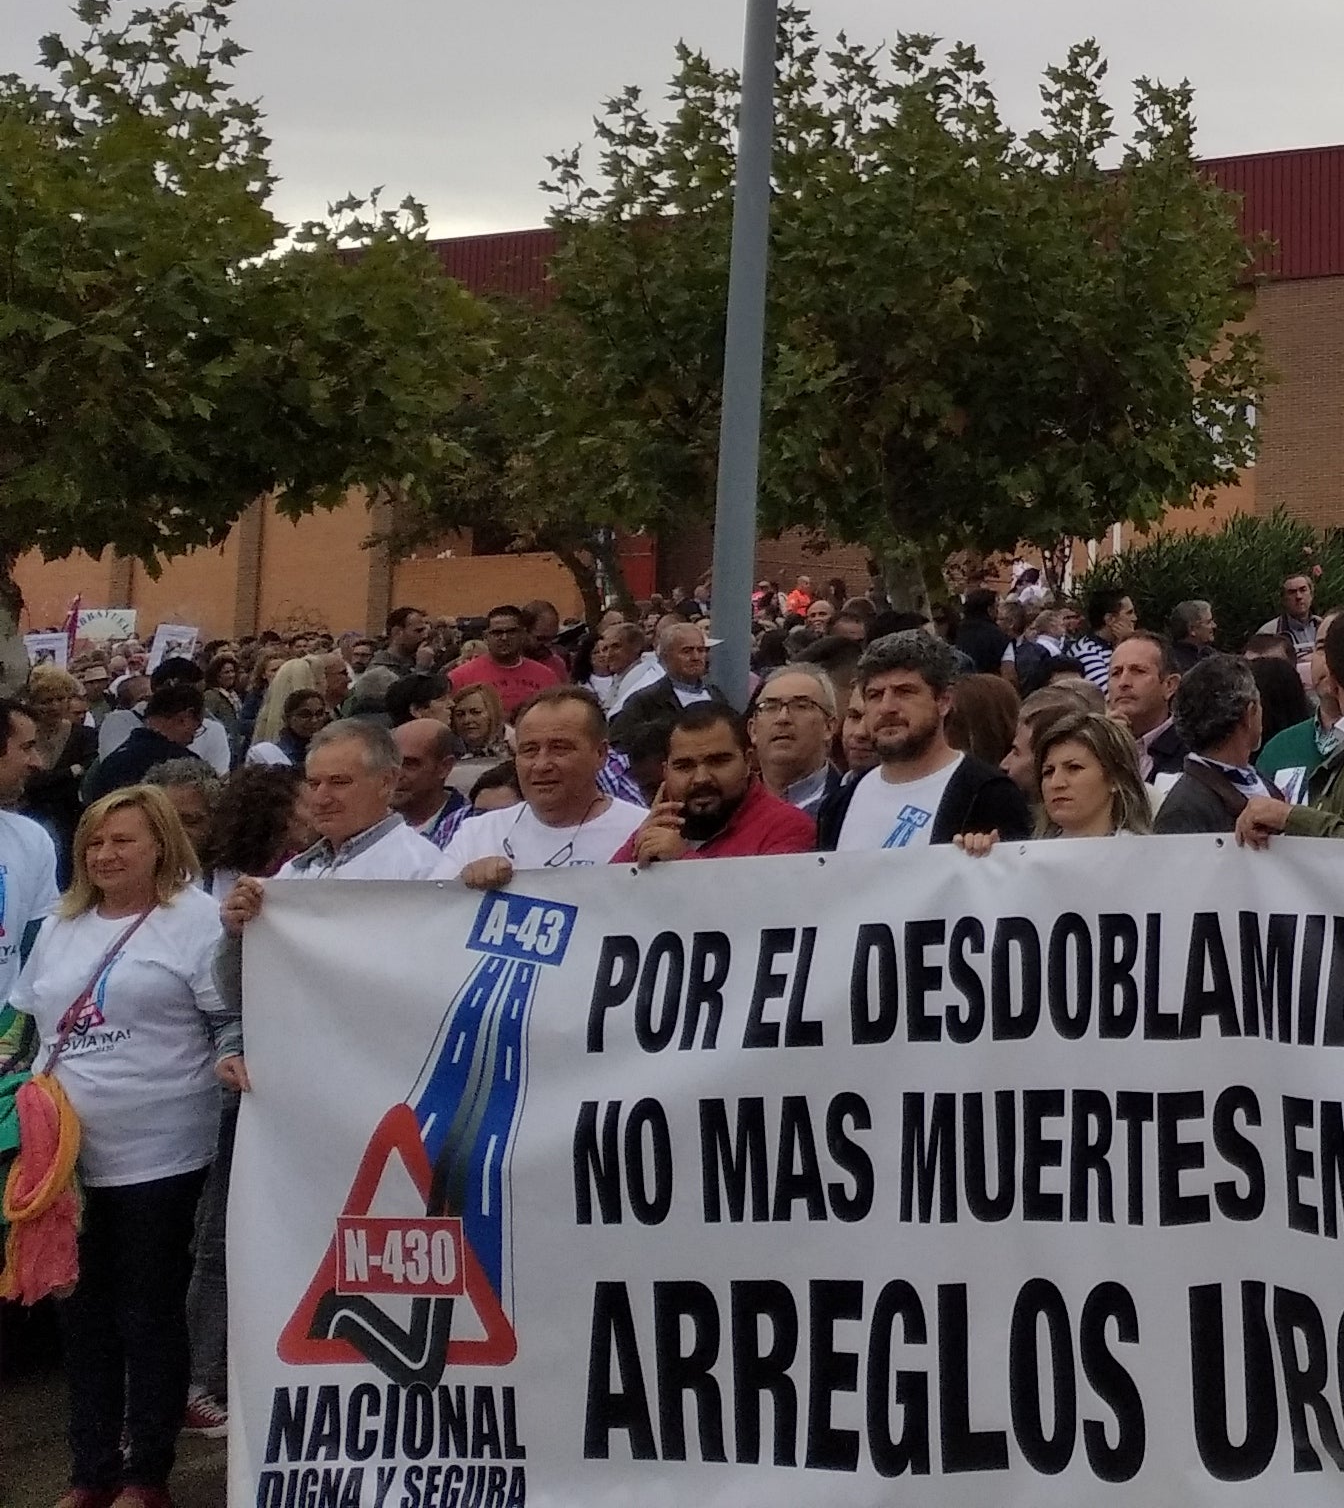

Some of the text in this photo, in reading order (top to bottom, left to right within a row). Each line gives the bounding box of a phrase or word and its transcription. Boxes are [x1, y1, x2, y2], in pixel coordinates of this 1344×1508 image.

[478, 898, 563, 958] A-43
[587, 928, 731, 1053] POR
[742, 926, 824, 1048] EL
[572, 1097, 674, 1225] NO
[699, 1091, 875, 1224] MAS
[900, 1085, 1266, 1227] MUERTES
[344, 1229, 456, 1284] N-430
[264, 1381, 527, 1464] NACIONAL
[584, 1277, 1146, 1486] ARREGLOS
[257, 1465, 527, 1508] DIGNA Y SEGURA
